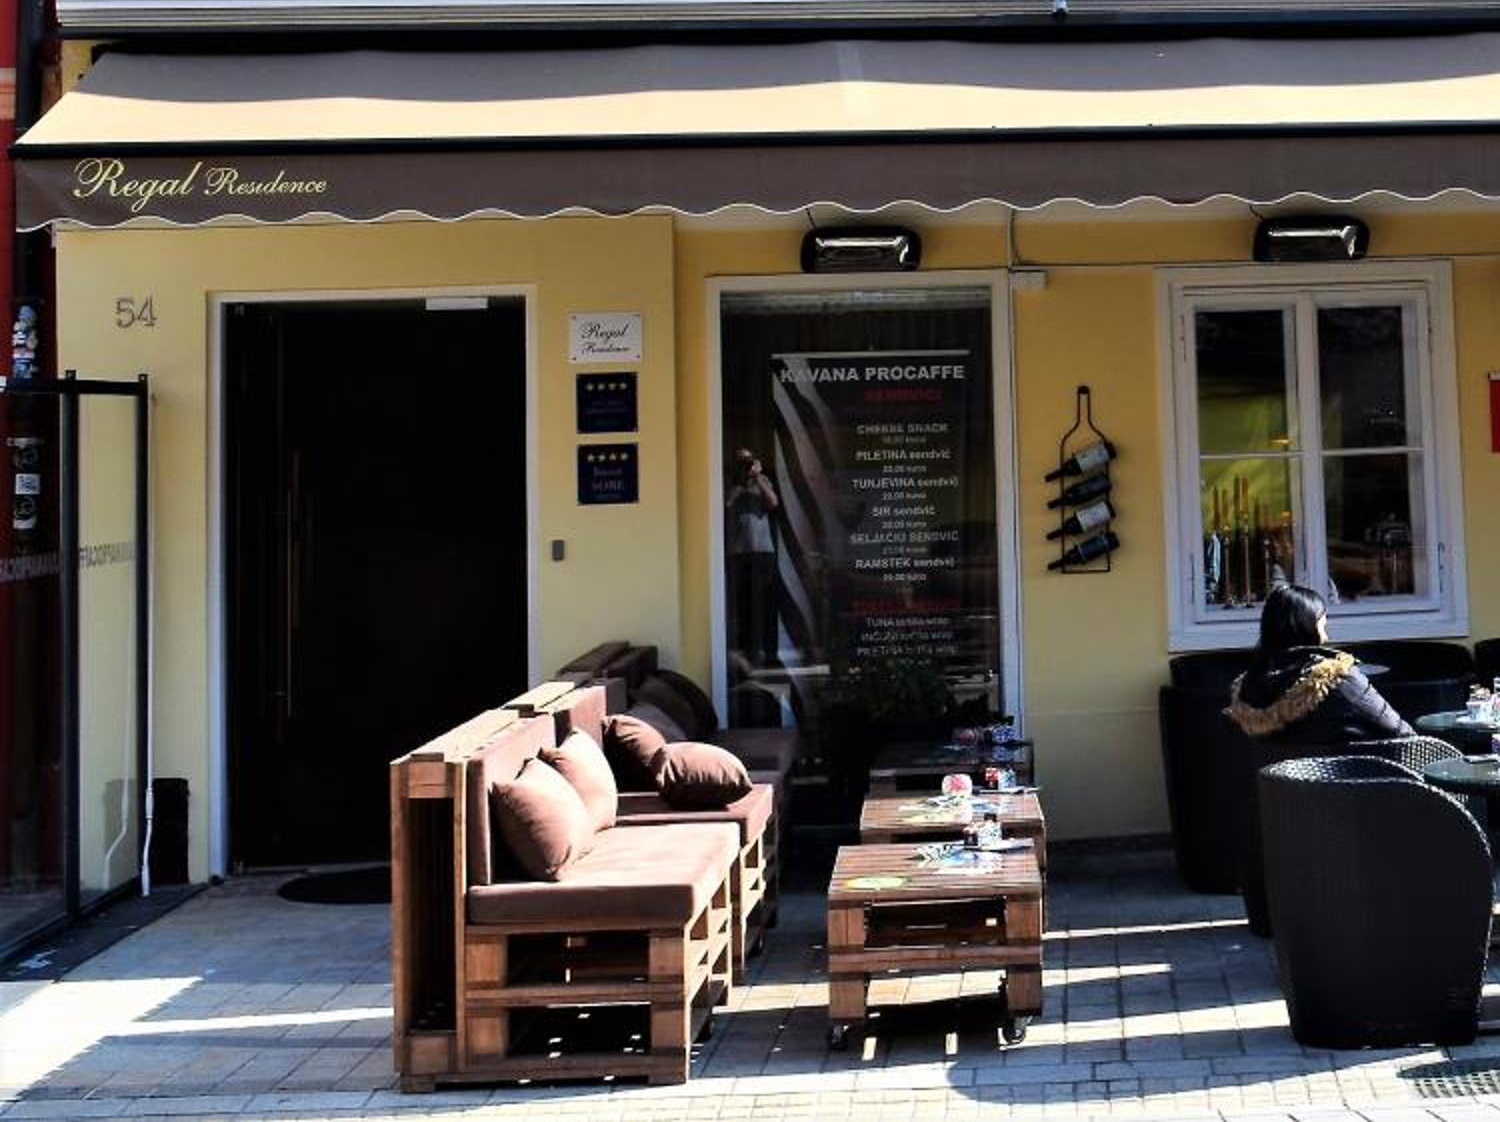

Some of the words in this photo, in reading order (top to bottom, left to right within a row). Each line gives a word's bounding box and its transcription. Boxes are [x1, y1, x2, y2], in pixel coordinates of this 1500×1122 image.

[73, 157, 203, 213] Regal
[204, 167, 328, 196] Residence
[115, 295, 158, 328] 54
[781, 366, 859, 383] KAVANA
[865, 365, 965, 381] PROCAFFE
